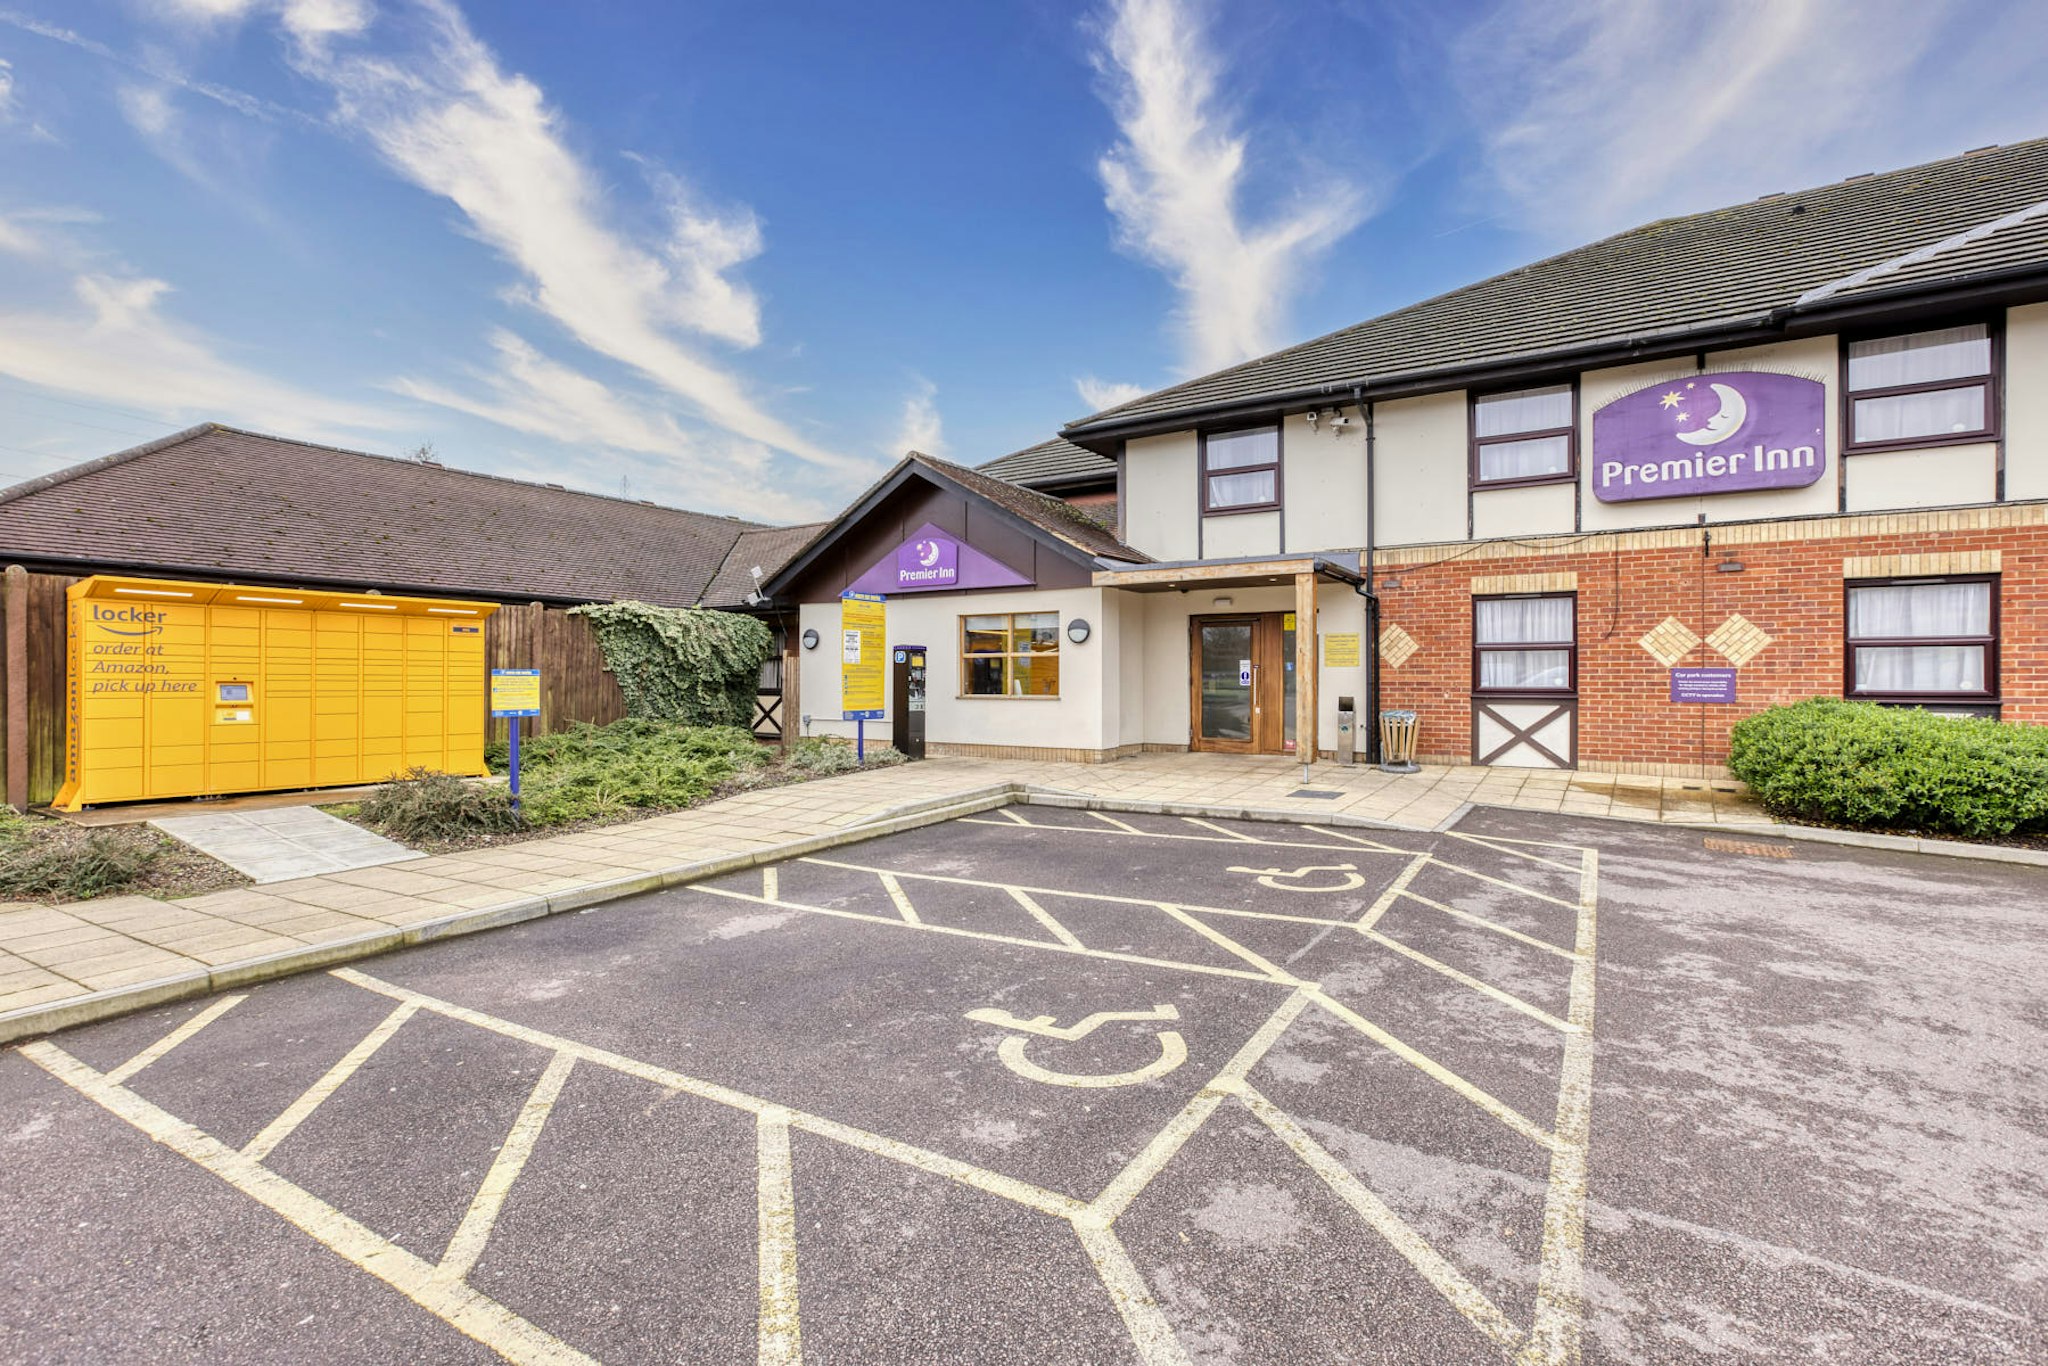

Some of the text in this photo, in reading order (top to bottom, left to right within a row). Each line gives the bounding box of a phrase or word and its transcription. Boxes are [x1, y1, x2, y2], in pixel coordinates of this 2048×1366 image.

[1602, 445, 1815, 487] Premier Inn
[899, 566, 955, 582] Premier Inn
[93, 604, 167, 623] locker
[93, 642, 164, 656] order at
[92, 660, 170, 675] Amazon,
[92, 679, 198, 694] pick up here
